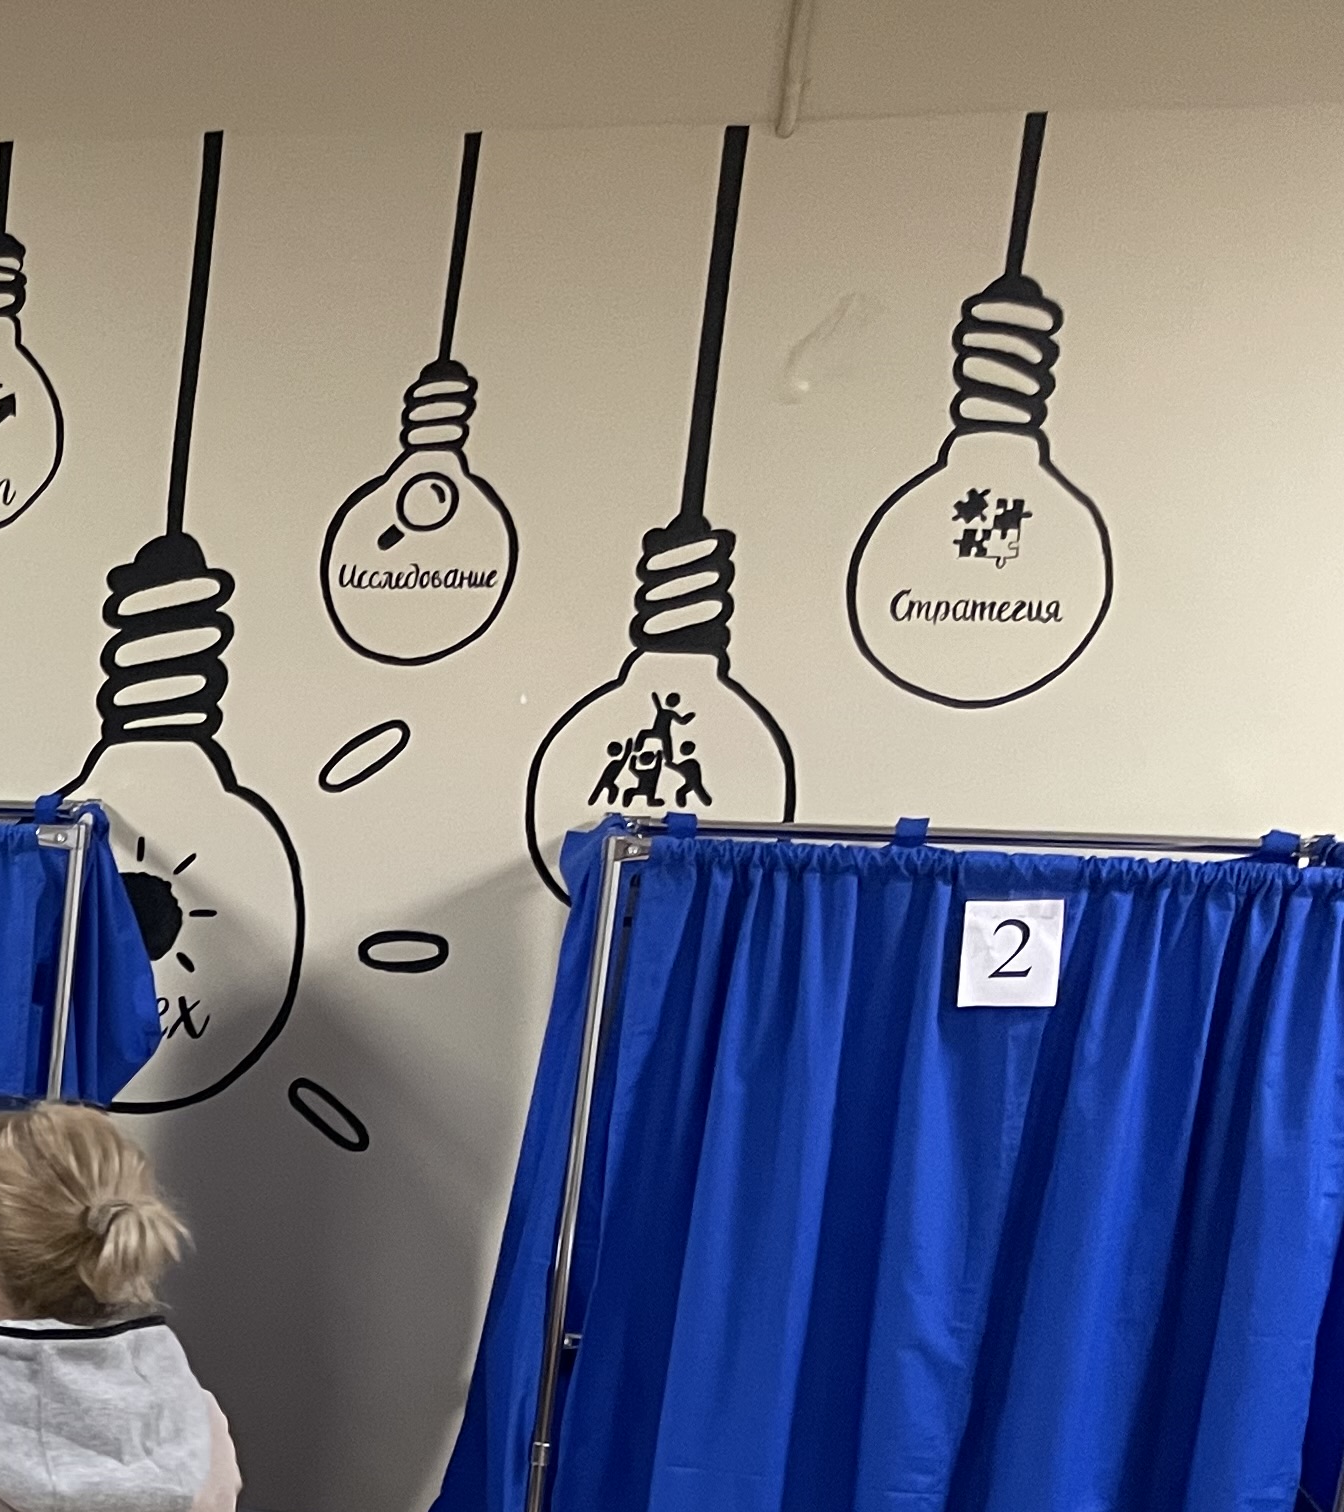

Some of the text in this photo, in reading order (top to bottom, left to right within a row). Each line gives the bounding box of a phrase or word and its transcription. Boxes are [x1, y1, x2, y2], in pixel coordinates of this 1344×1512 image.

[337, 563, 500, 592] Исследование
[888, 588, 1064, 626] Стратегия
[987, 918, 1033, 979] 2
[157, 995, 211, 1040] ех
